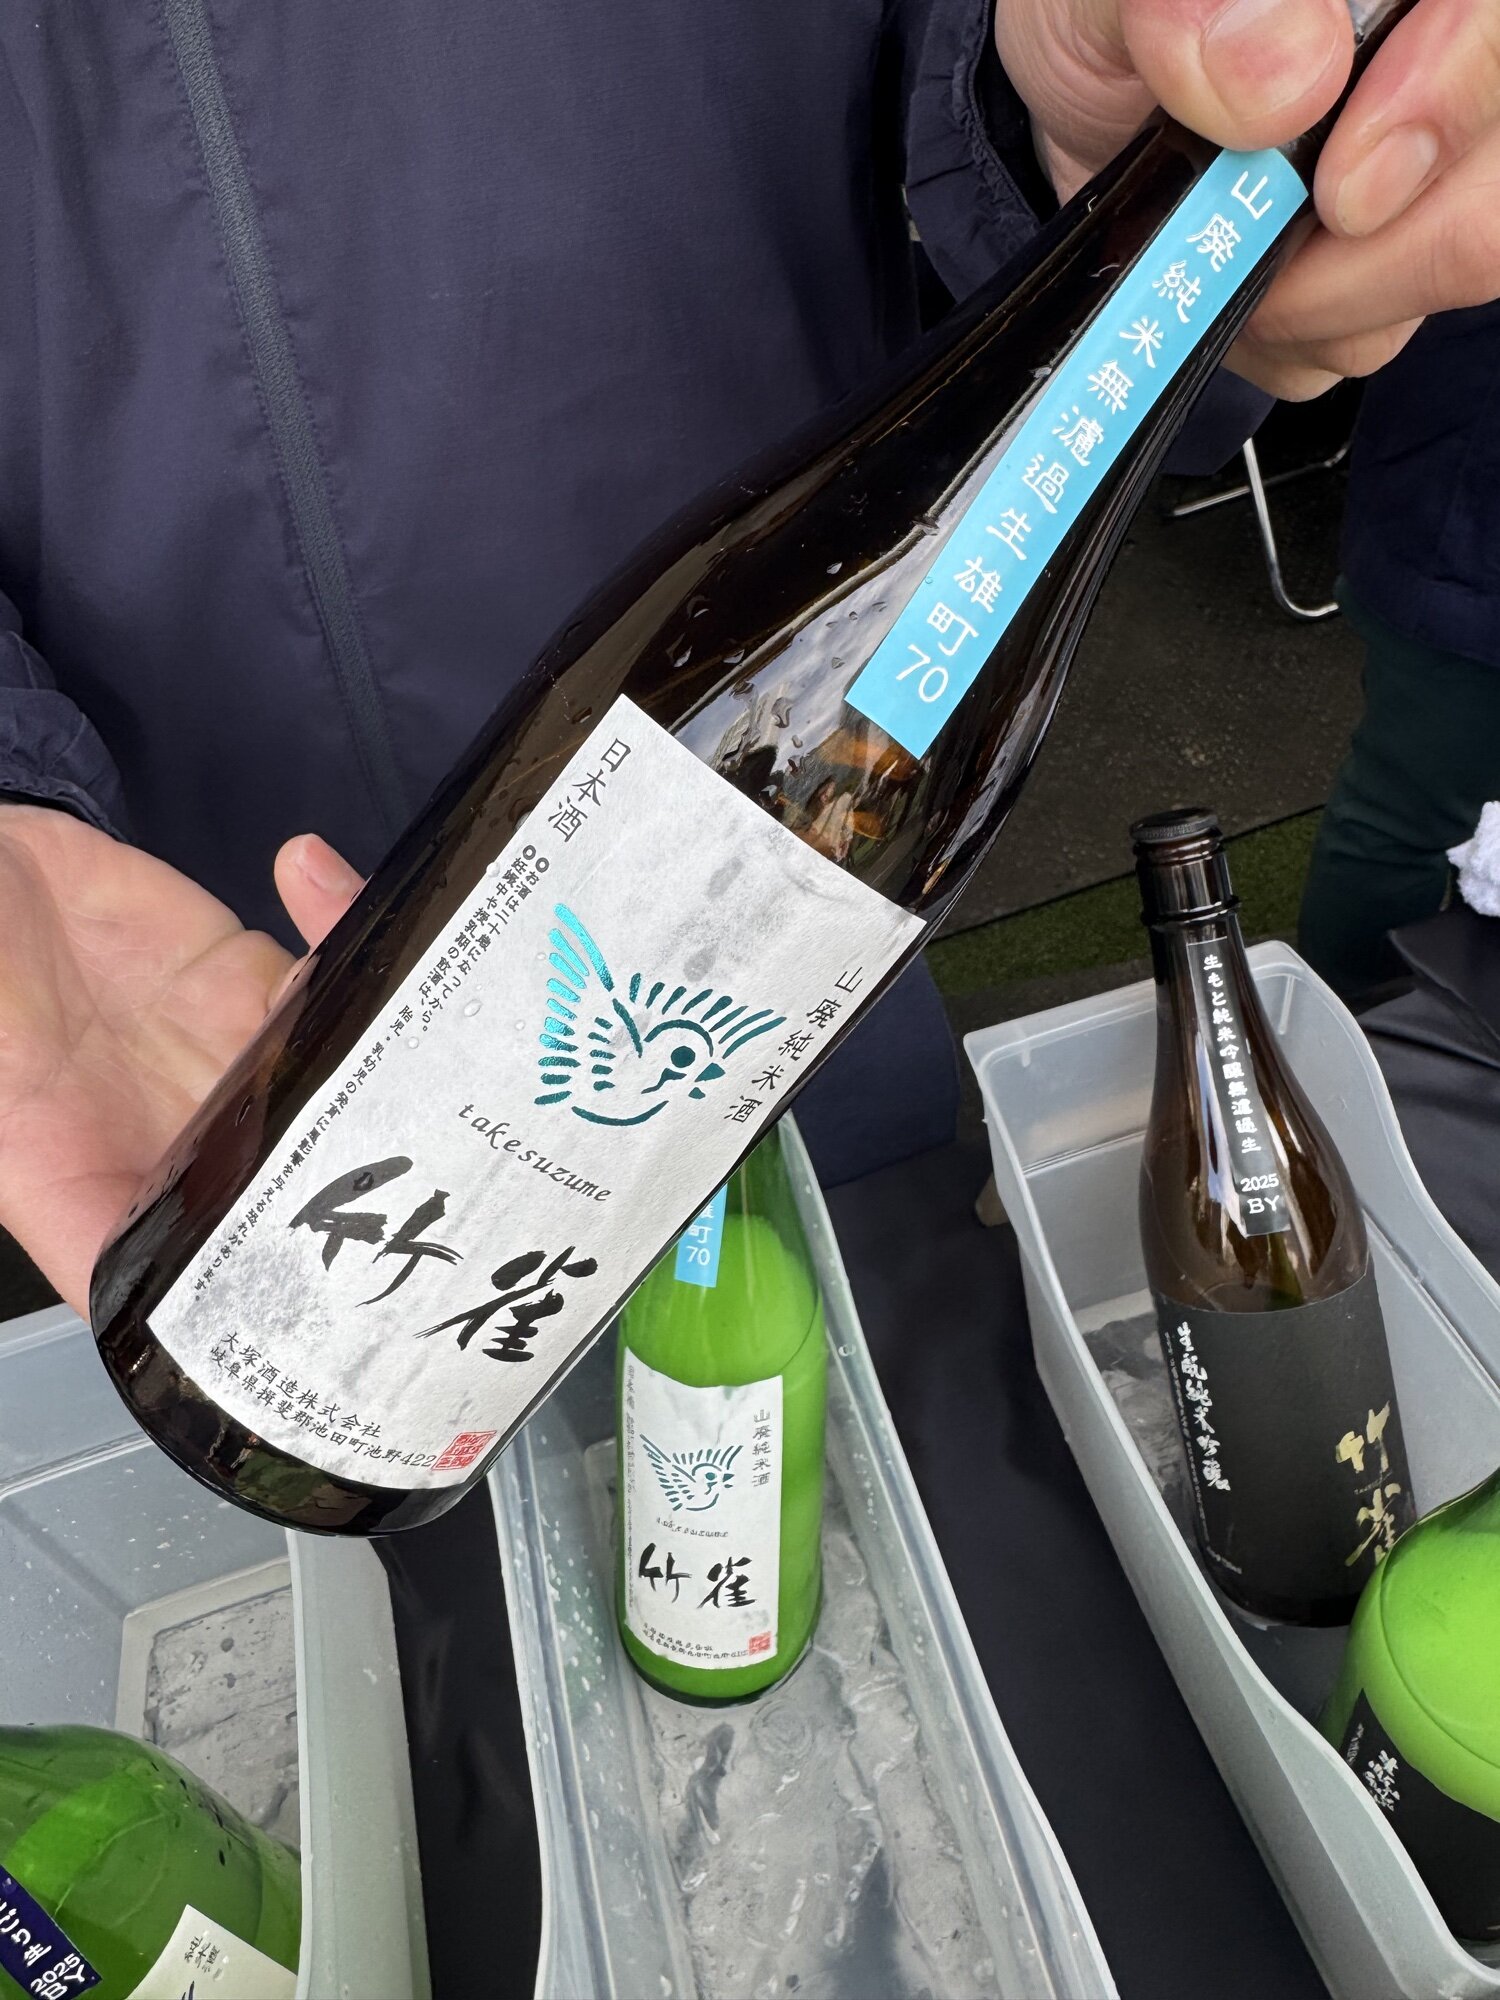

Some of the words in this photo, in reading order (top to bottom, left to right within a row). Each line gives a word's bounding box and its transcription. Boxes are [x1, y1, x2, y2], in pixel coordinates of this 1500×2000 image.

[546, 738, 632, 844] 日本酒
[725, 966, 865, 1124] 山廃純米酒
[459, 1102, 613, 1204] takesuzume
[1240, 1173, 1280, 1193] 2025
[1247, 1196, 1280, 1214] BY
[288, 1156, 598, 1362] 竹雀
[209, 1345, 436, 1469] 岐阜県揖斐郡池田町池野422
[221, 1331, 382, 1440] 大塚酒造株式会社
[638, 1541, 758, 1609] 竹雀
[30, 1953, 81, 1993] 2025
[42, 1964, 86, 2000] BY
